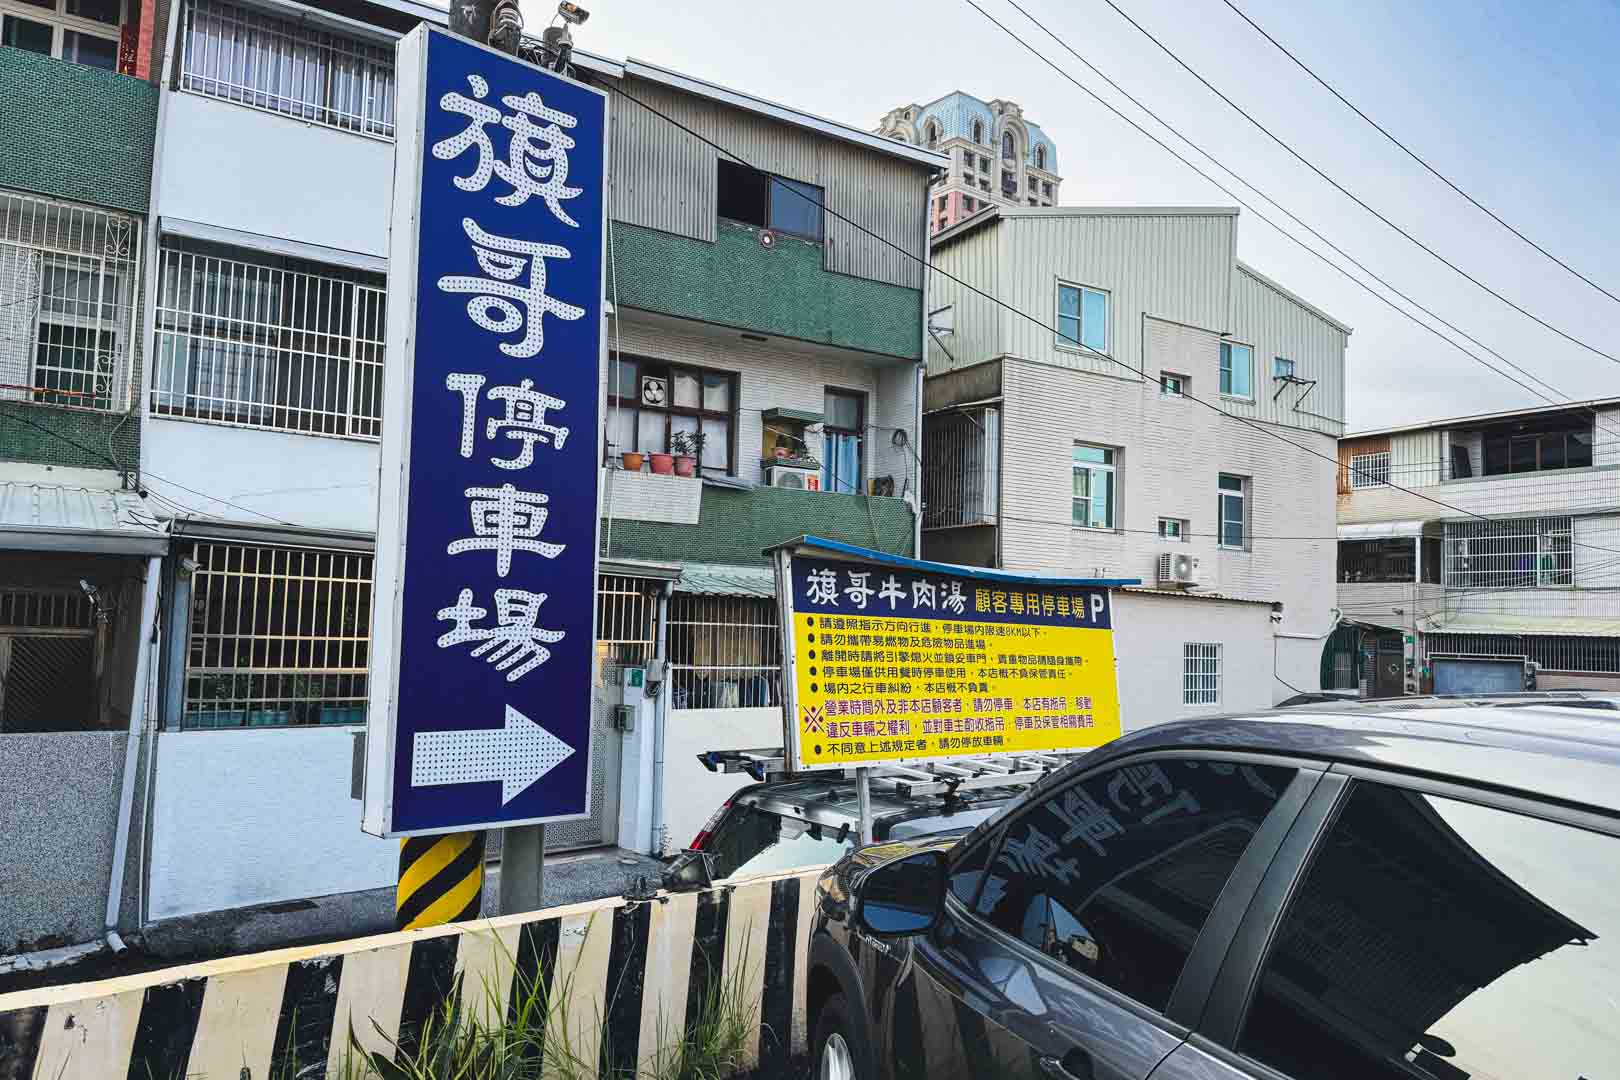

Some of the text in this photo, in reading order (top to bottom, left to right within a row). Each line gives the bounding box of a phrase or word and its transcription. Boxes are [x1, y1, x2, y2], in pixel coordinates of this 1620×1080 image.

[806, 567, 1105, 624] 旗哥牛肉湯 顧客專用停車場 P
